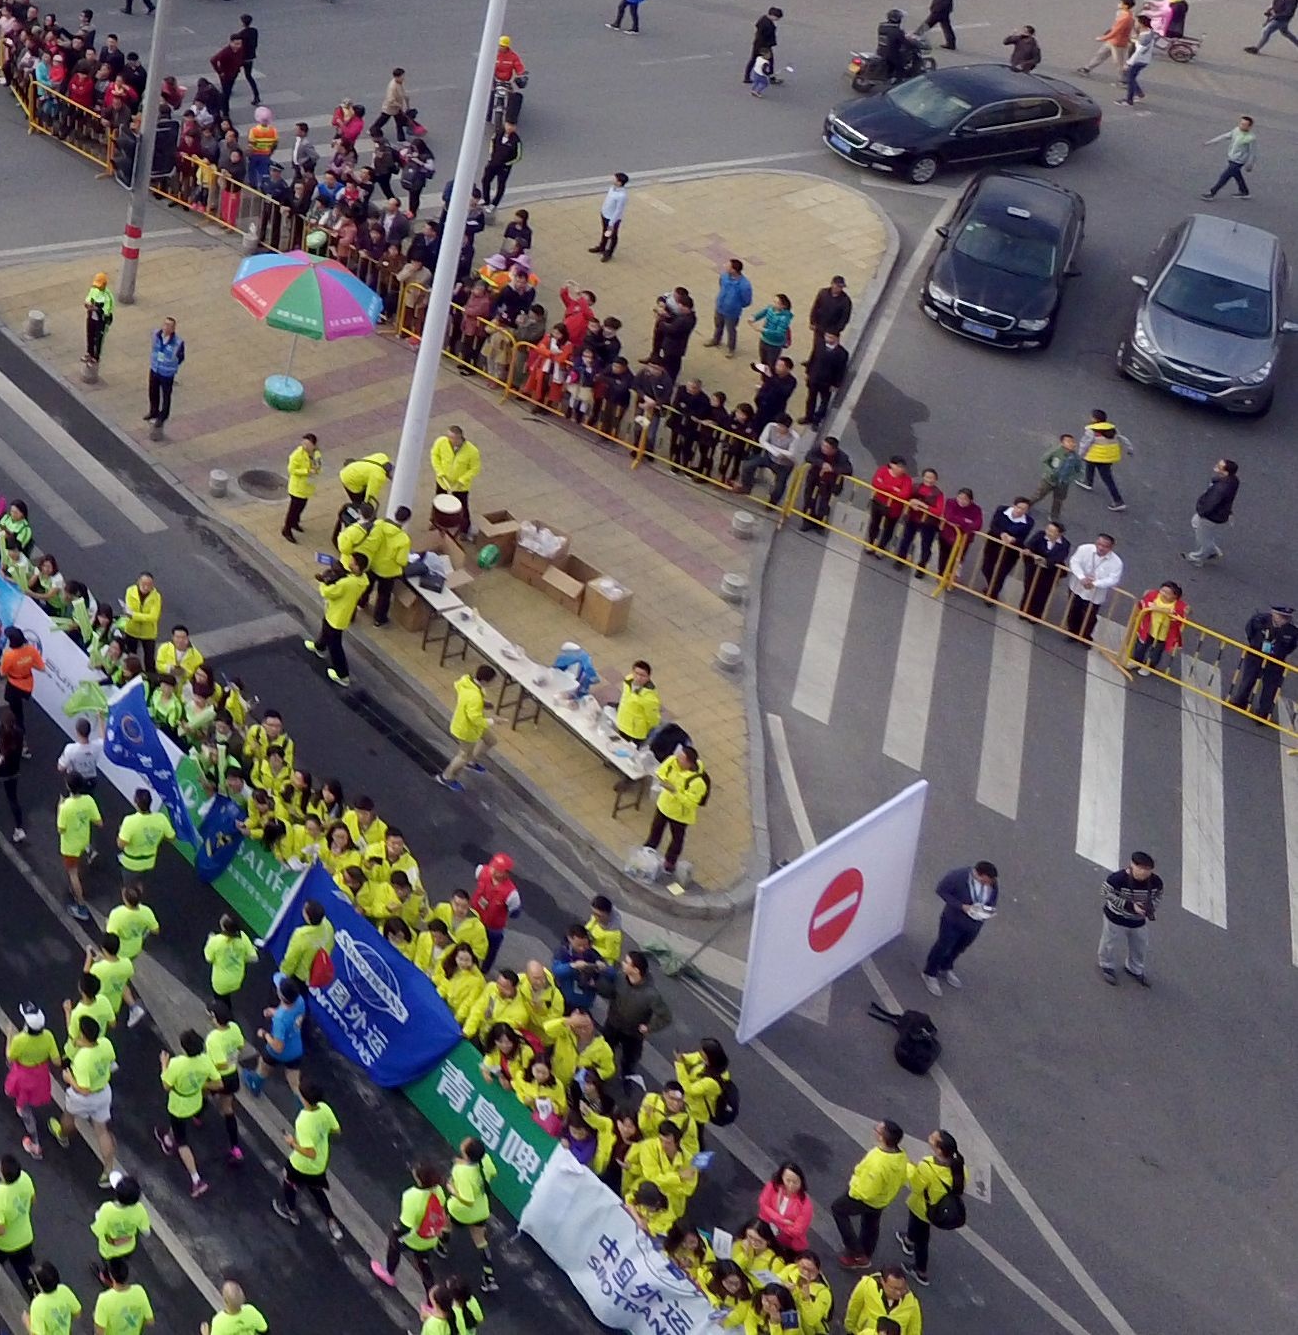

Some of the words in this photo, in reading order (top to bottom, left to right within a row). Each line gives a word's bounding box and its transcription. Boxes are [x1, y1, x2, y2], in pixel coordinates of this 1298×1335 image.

[326, 978, 389, 1059] 国外运
[436, 1058, 542, 1186] 青島啤
[587, 1255, 671, 1335] SINOTRAN
